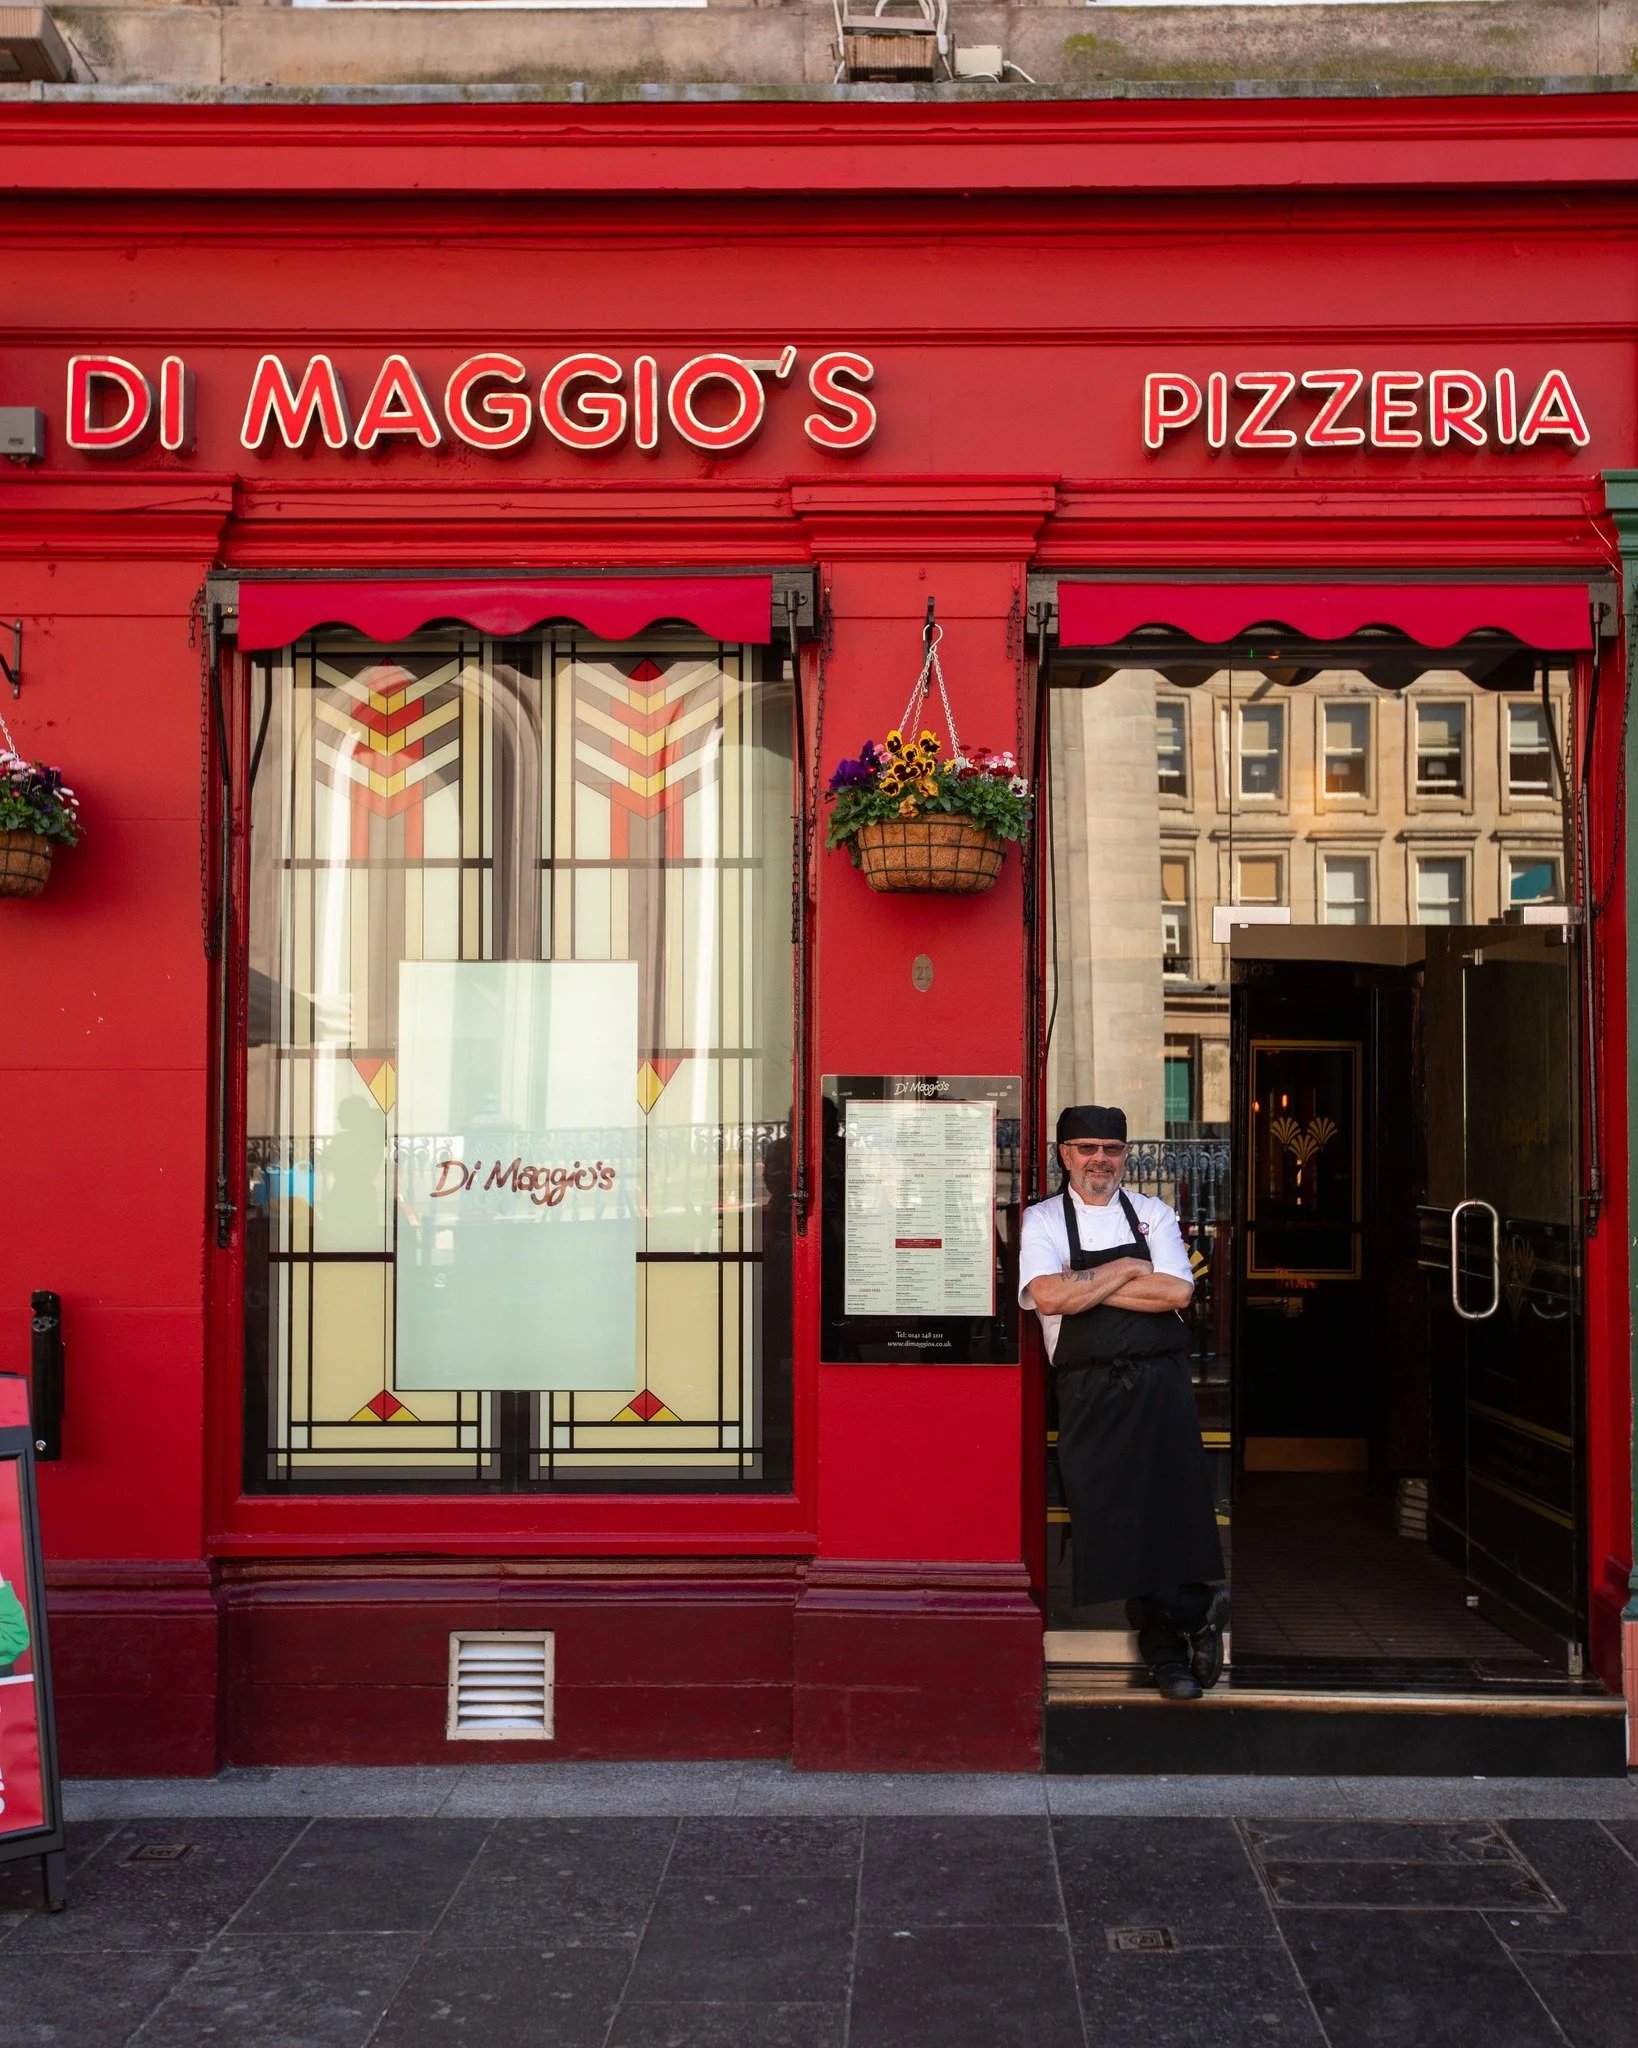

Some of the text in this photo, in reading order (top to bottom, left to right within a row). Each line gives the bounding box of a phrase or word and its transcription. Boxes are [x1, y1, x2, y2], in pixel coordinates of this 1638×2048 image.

[65, 345, 878, 451] DI MAGGIO'S
[1144, 367, 1591, 448] PIZZERIA
[893, 1080, 950, 1096] Di Maggio's
[429, 1157, 616, 1207] Di Maggio's
[887, 1340, 952, 1348] www.dimaggios.co.uk
